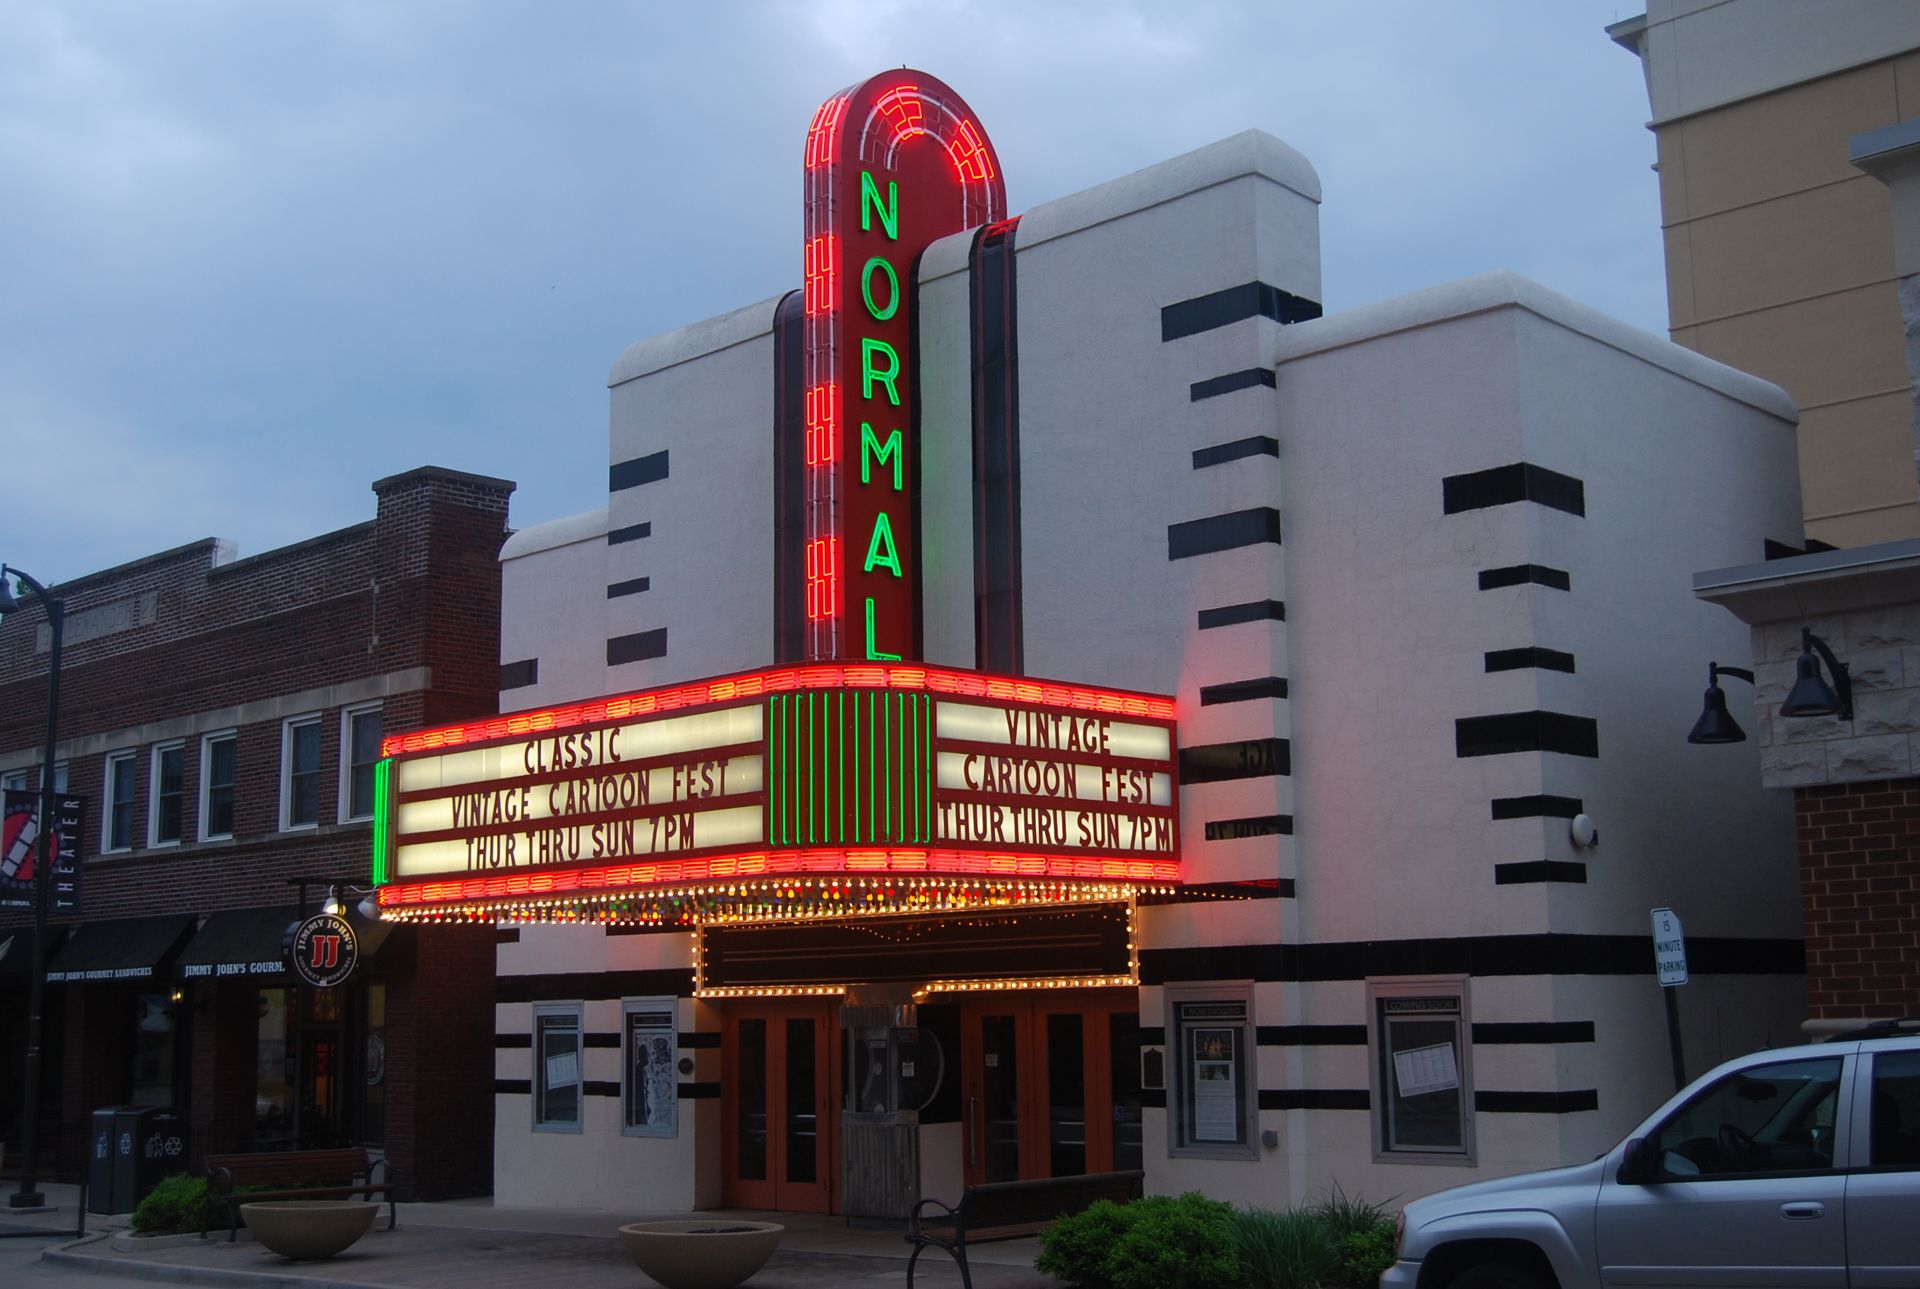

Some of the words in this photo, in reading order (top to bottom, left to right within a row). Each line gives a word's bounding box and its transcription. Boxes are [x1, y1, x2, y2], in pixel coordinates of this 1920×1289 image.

[861, 170, 902, 661] NORMAL
[524, 727, 622, 775] CLASSIC
[1005, 709, 1111, 754] VINTAGE
[451, 786, 531, 829] VINTAGE
[549, 769, 651, 816] CARTOON
[672, 760, 729, 801] FEST
[963, 754, 1077, 799] CARTOON
[1102, 767, 1153, 805] FEST
[465, 834, 517, 872] THUR
[526, 825, 581, 866] THRU
[591, 820, 636, 859] SUN
[650, 813, 695, 854] 7PM
[938, 802, 1004, 842] THUR
[1010, 806, 1067, 846] THRU
[1077, 812, 1121, 849] SUN
[1127, 815, 1174, 852] 7PM
[58, 801, 80, 907] THEATER
[298, 919, 325, 950] JIMMY
[327, 919, 353, 951] JOHN'S
[1662, 920, 1671, 932] 15
[311, 935, 340, 968] JJ
[1657, 940, 1682, 952] MINUTE
[47, 971, 65, 982] JIMMY
[66, 970, 85, 982] JOHN'S
[86, 969, 114, 980] GOURMET
[115, 966, 153, 979] SANDWICHES
[184, 964, 213, 977] JIMMY
[217, 963, 246, 977] JOHN'S
[250, 961, 286, 974] GOURM.
[1658, 960, 1685, 972] PARKING
[1427, 1000, 1454, 1009] SOON
